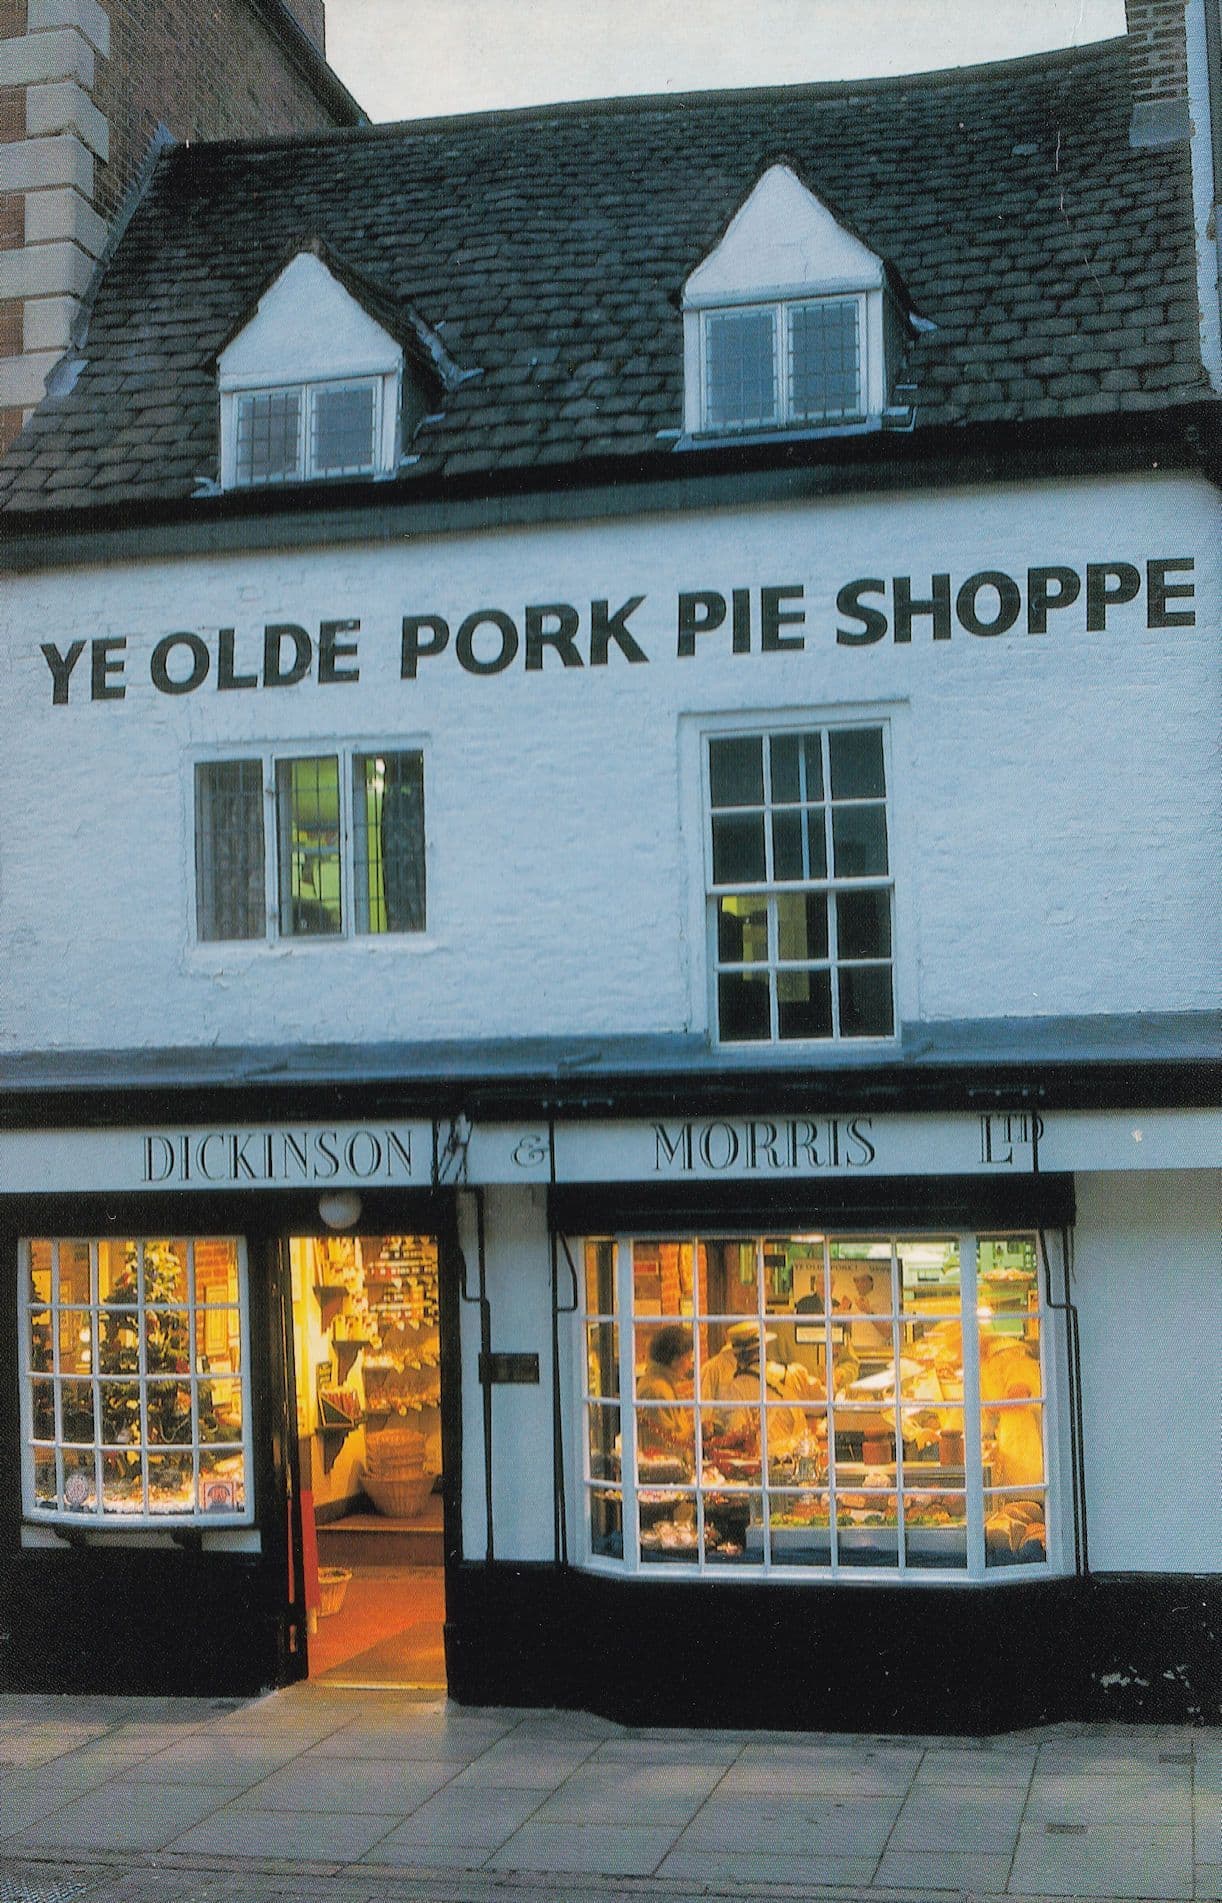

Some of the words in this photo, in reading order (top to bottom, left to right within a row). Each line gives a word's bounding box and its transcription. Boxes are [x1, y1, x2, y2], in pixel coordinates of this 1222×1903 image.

[40, 636, 127, 706] YE
[150, 619, 361, 695] OLDE
[400, 596, 649, 680] PORK
[677, 584, 806, 657] PIE
[836, 556, 1196, 647] SHOPPE
[140, 1129, 413, 1182] DICKINSON
[511, 1134, 549, 1168] &
[651, 1117, 876, 1171] MORRIS
